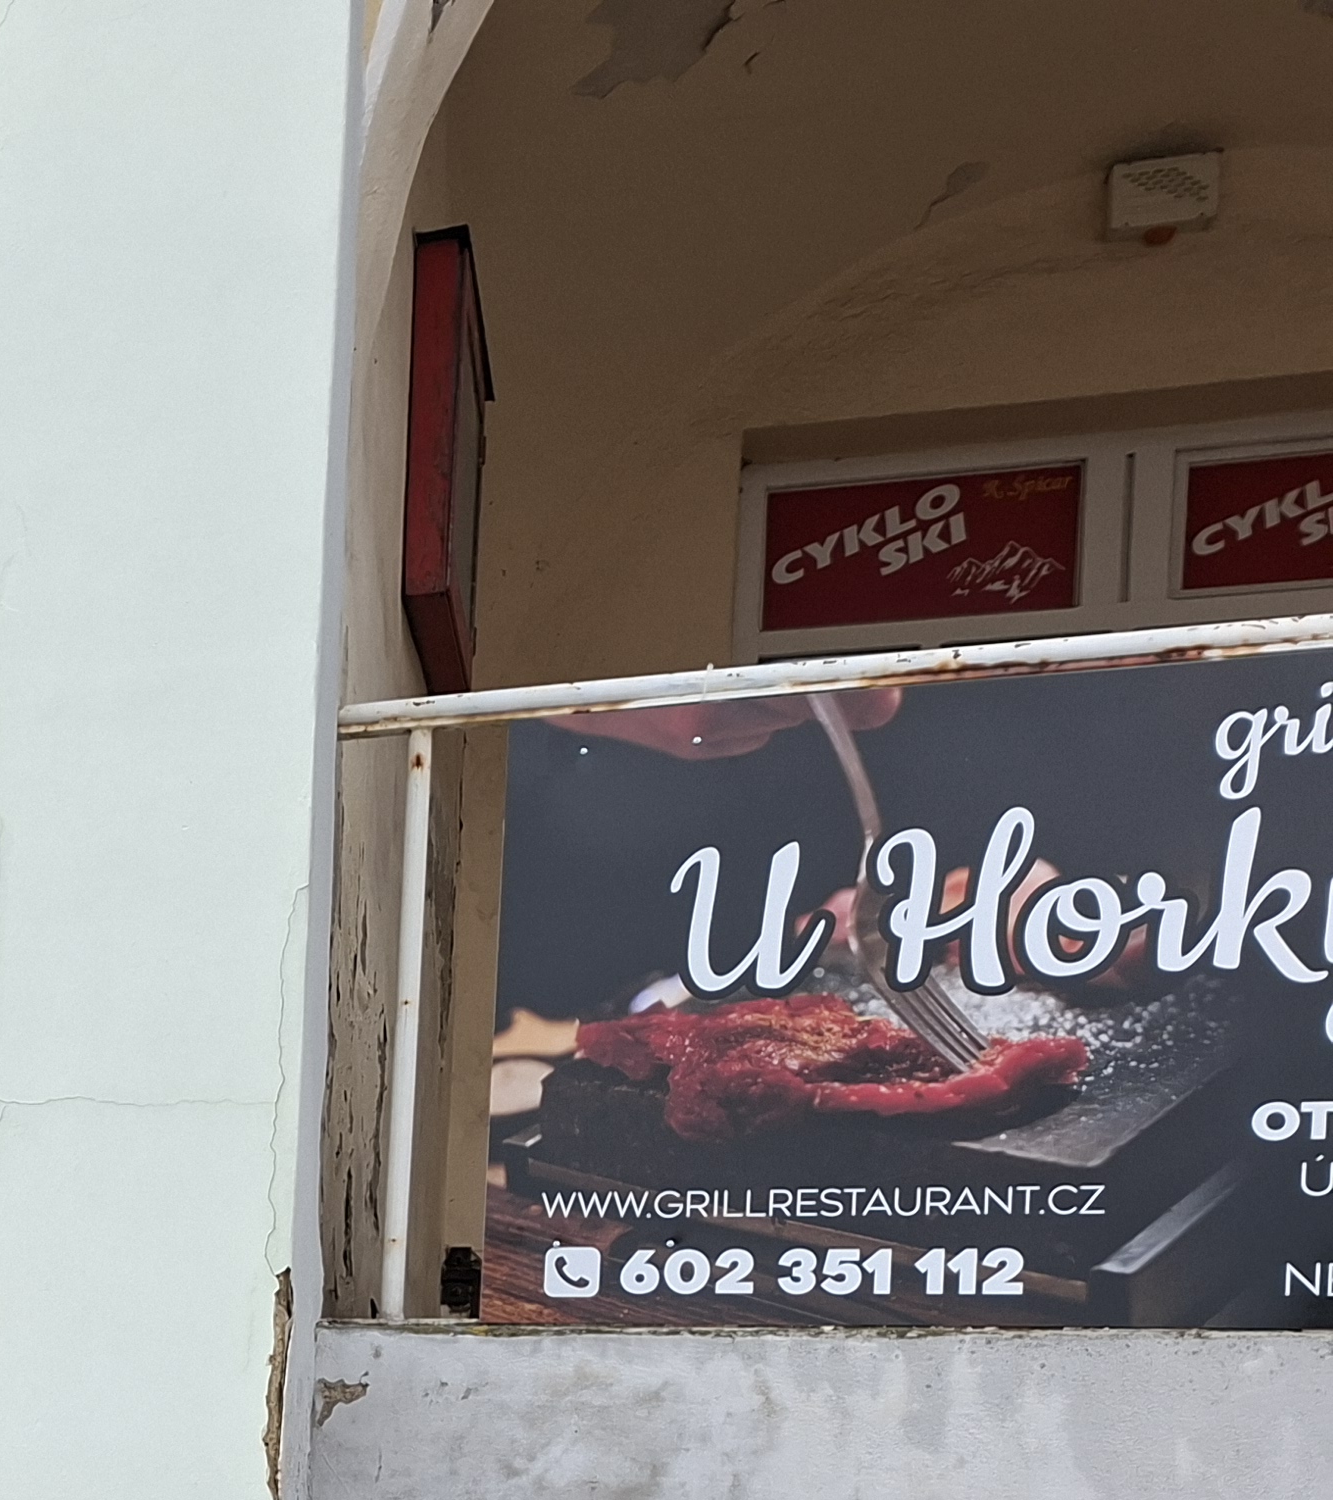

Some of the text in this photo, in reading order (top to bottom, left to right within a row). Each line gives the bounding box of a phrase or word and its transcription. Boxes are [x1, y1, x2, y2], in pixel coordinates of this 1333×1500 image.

[771, 483, 961, 584] CYKLO
[877, 511, 967, 577] SKI
[1299, 506, 1333, 546] S
[670, 806, 1333, 992] U Hork
[542, 1185, 1106, 1218] WWW.GRILLRESTAURANT.CZ
[619, 1247, 1025, 1295] 602 351 112
